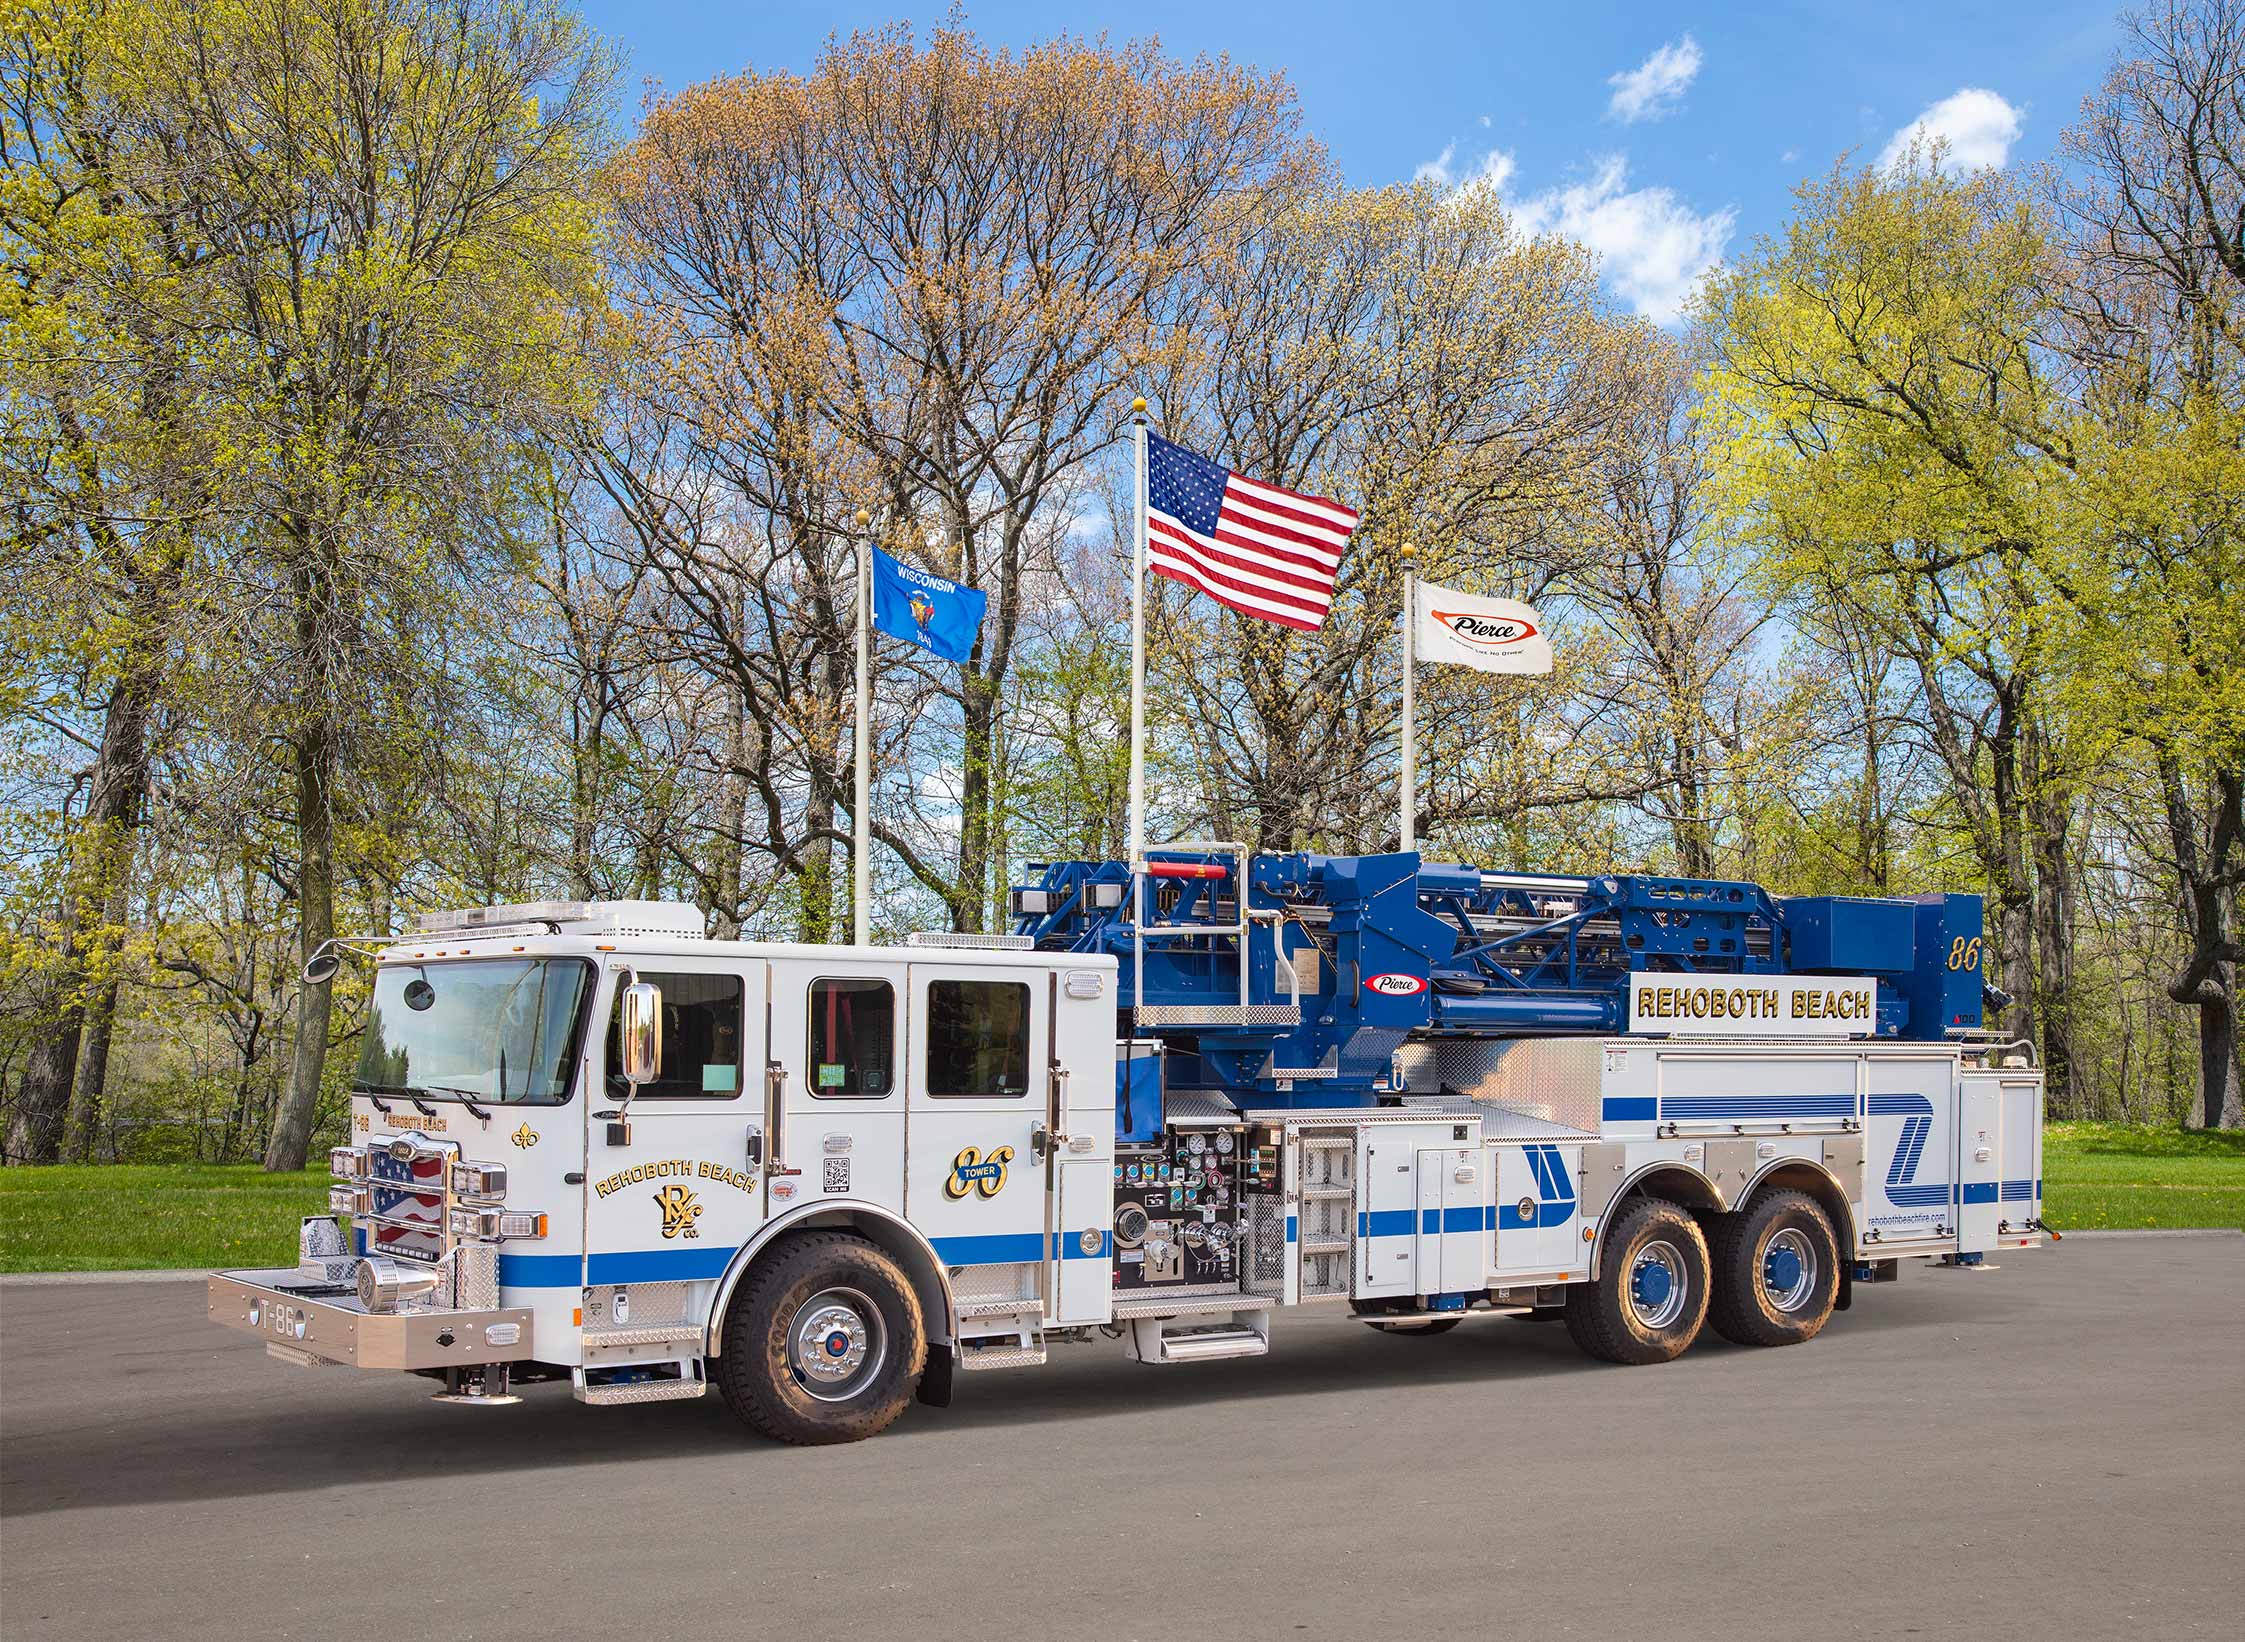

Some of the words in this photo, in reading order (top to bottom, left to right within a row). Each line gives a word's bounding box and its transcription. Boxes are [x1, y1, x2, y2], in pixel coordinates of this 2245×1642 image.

[897, 565, 956, 594] WISCONSIN
[1454, 616, 1515, 637] Pierce
[1948, 936, 1982, 971] 86
[1379, 976, 1414, 990] Pierce
[1638, 987, 1780, 1018] REHOBOTH
[1791, 990, 1871, 1019] BEACH
[594, 1159, 693, 1199] REHOBOTH
[698, 1161, 758, 1194] BEACH
[945, 1145, 1015, 1199] 86
[964, 1166, 995, 1178] TOWER
[261, 1299, 294, 1336] T-86
